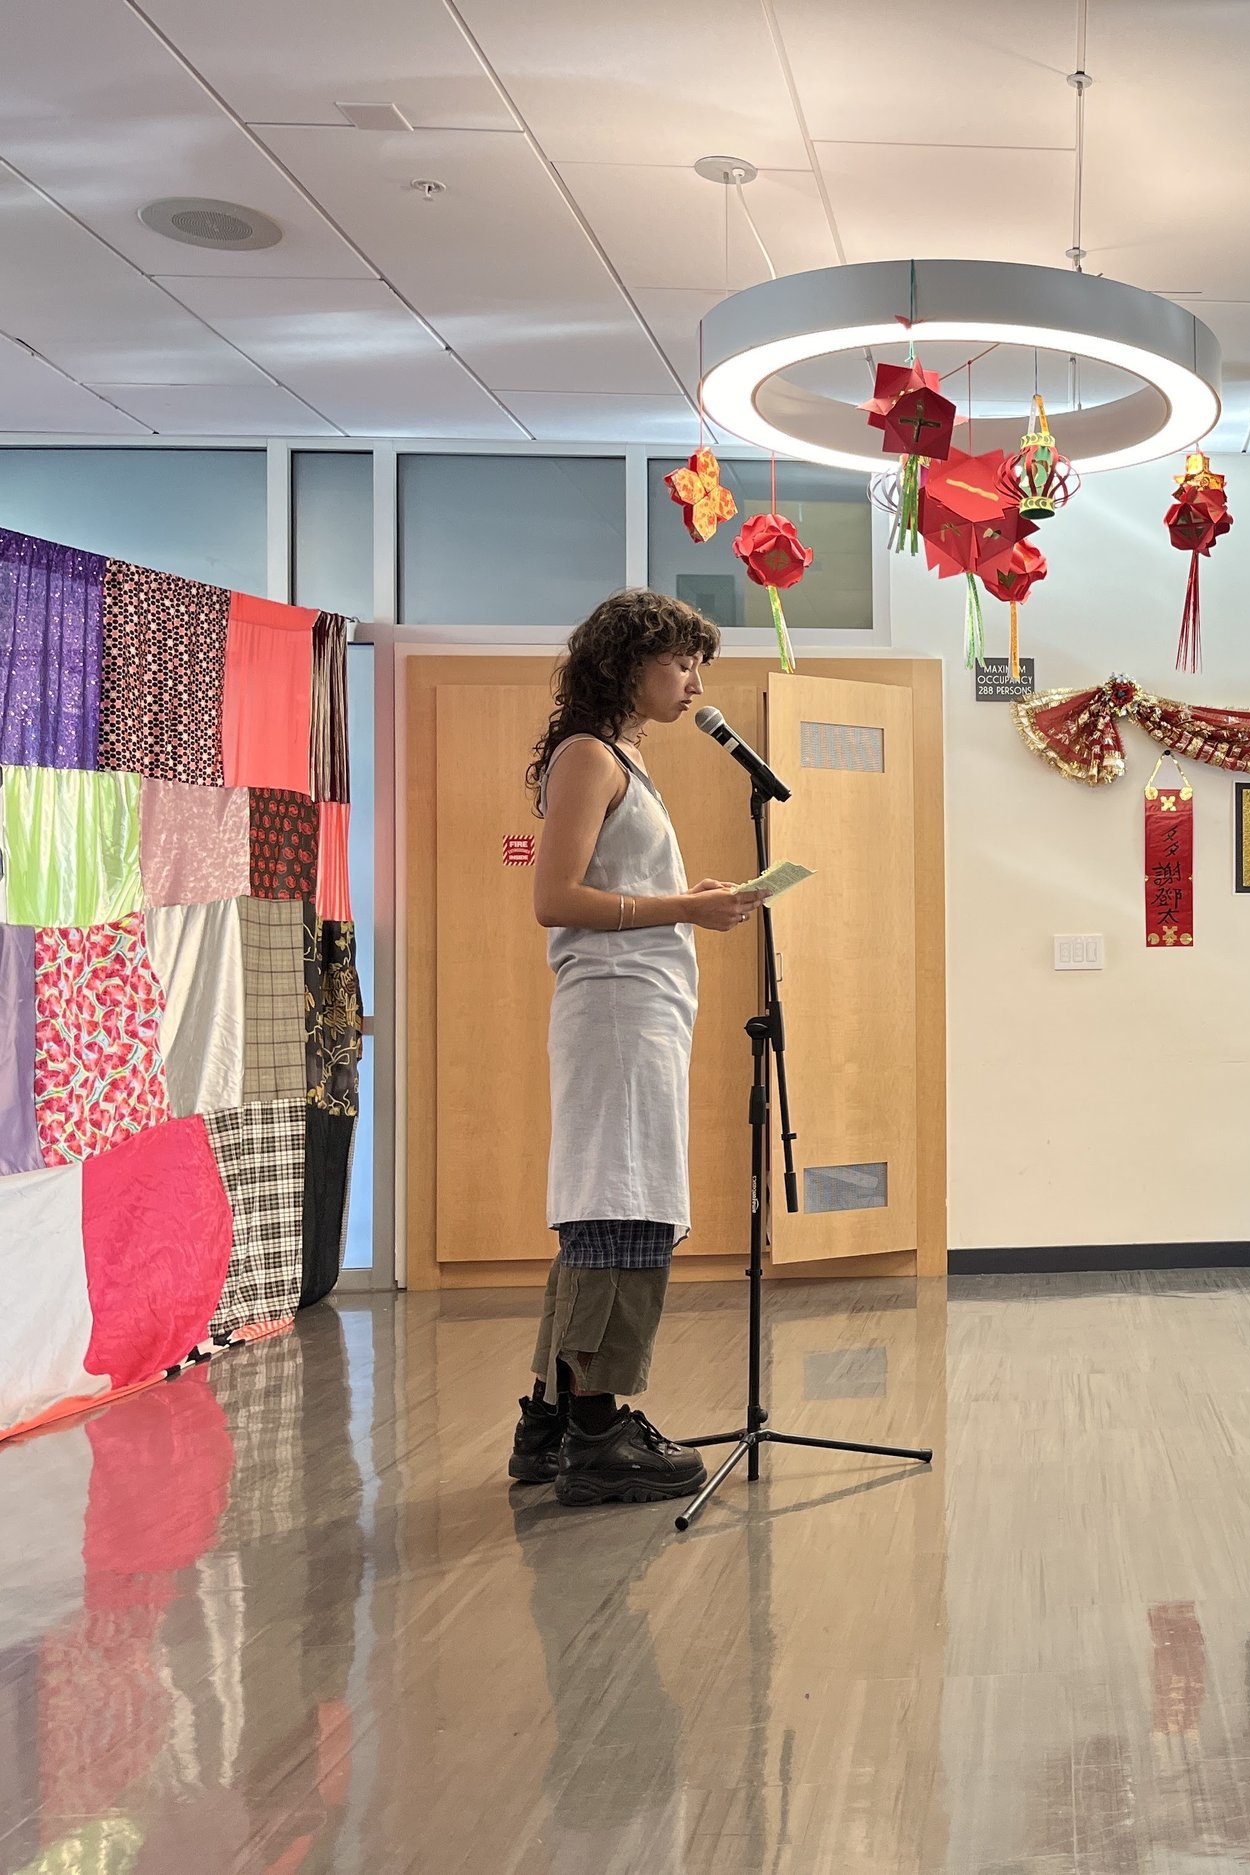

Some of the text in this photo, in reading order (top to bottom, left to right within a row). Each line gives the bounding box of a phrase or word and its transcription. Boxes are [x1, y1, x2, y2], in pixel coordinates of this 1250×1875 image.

[983, 665, 1026, 673] MAXIM
[978, 686, 1032, 695] 288 PERSONS
